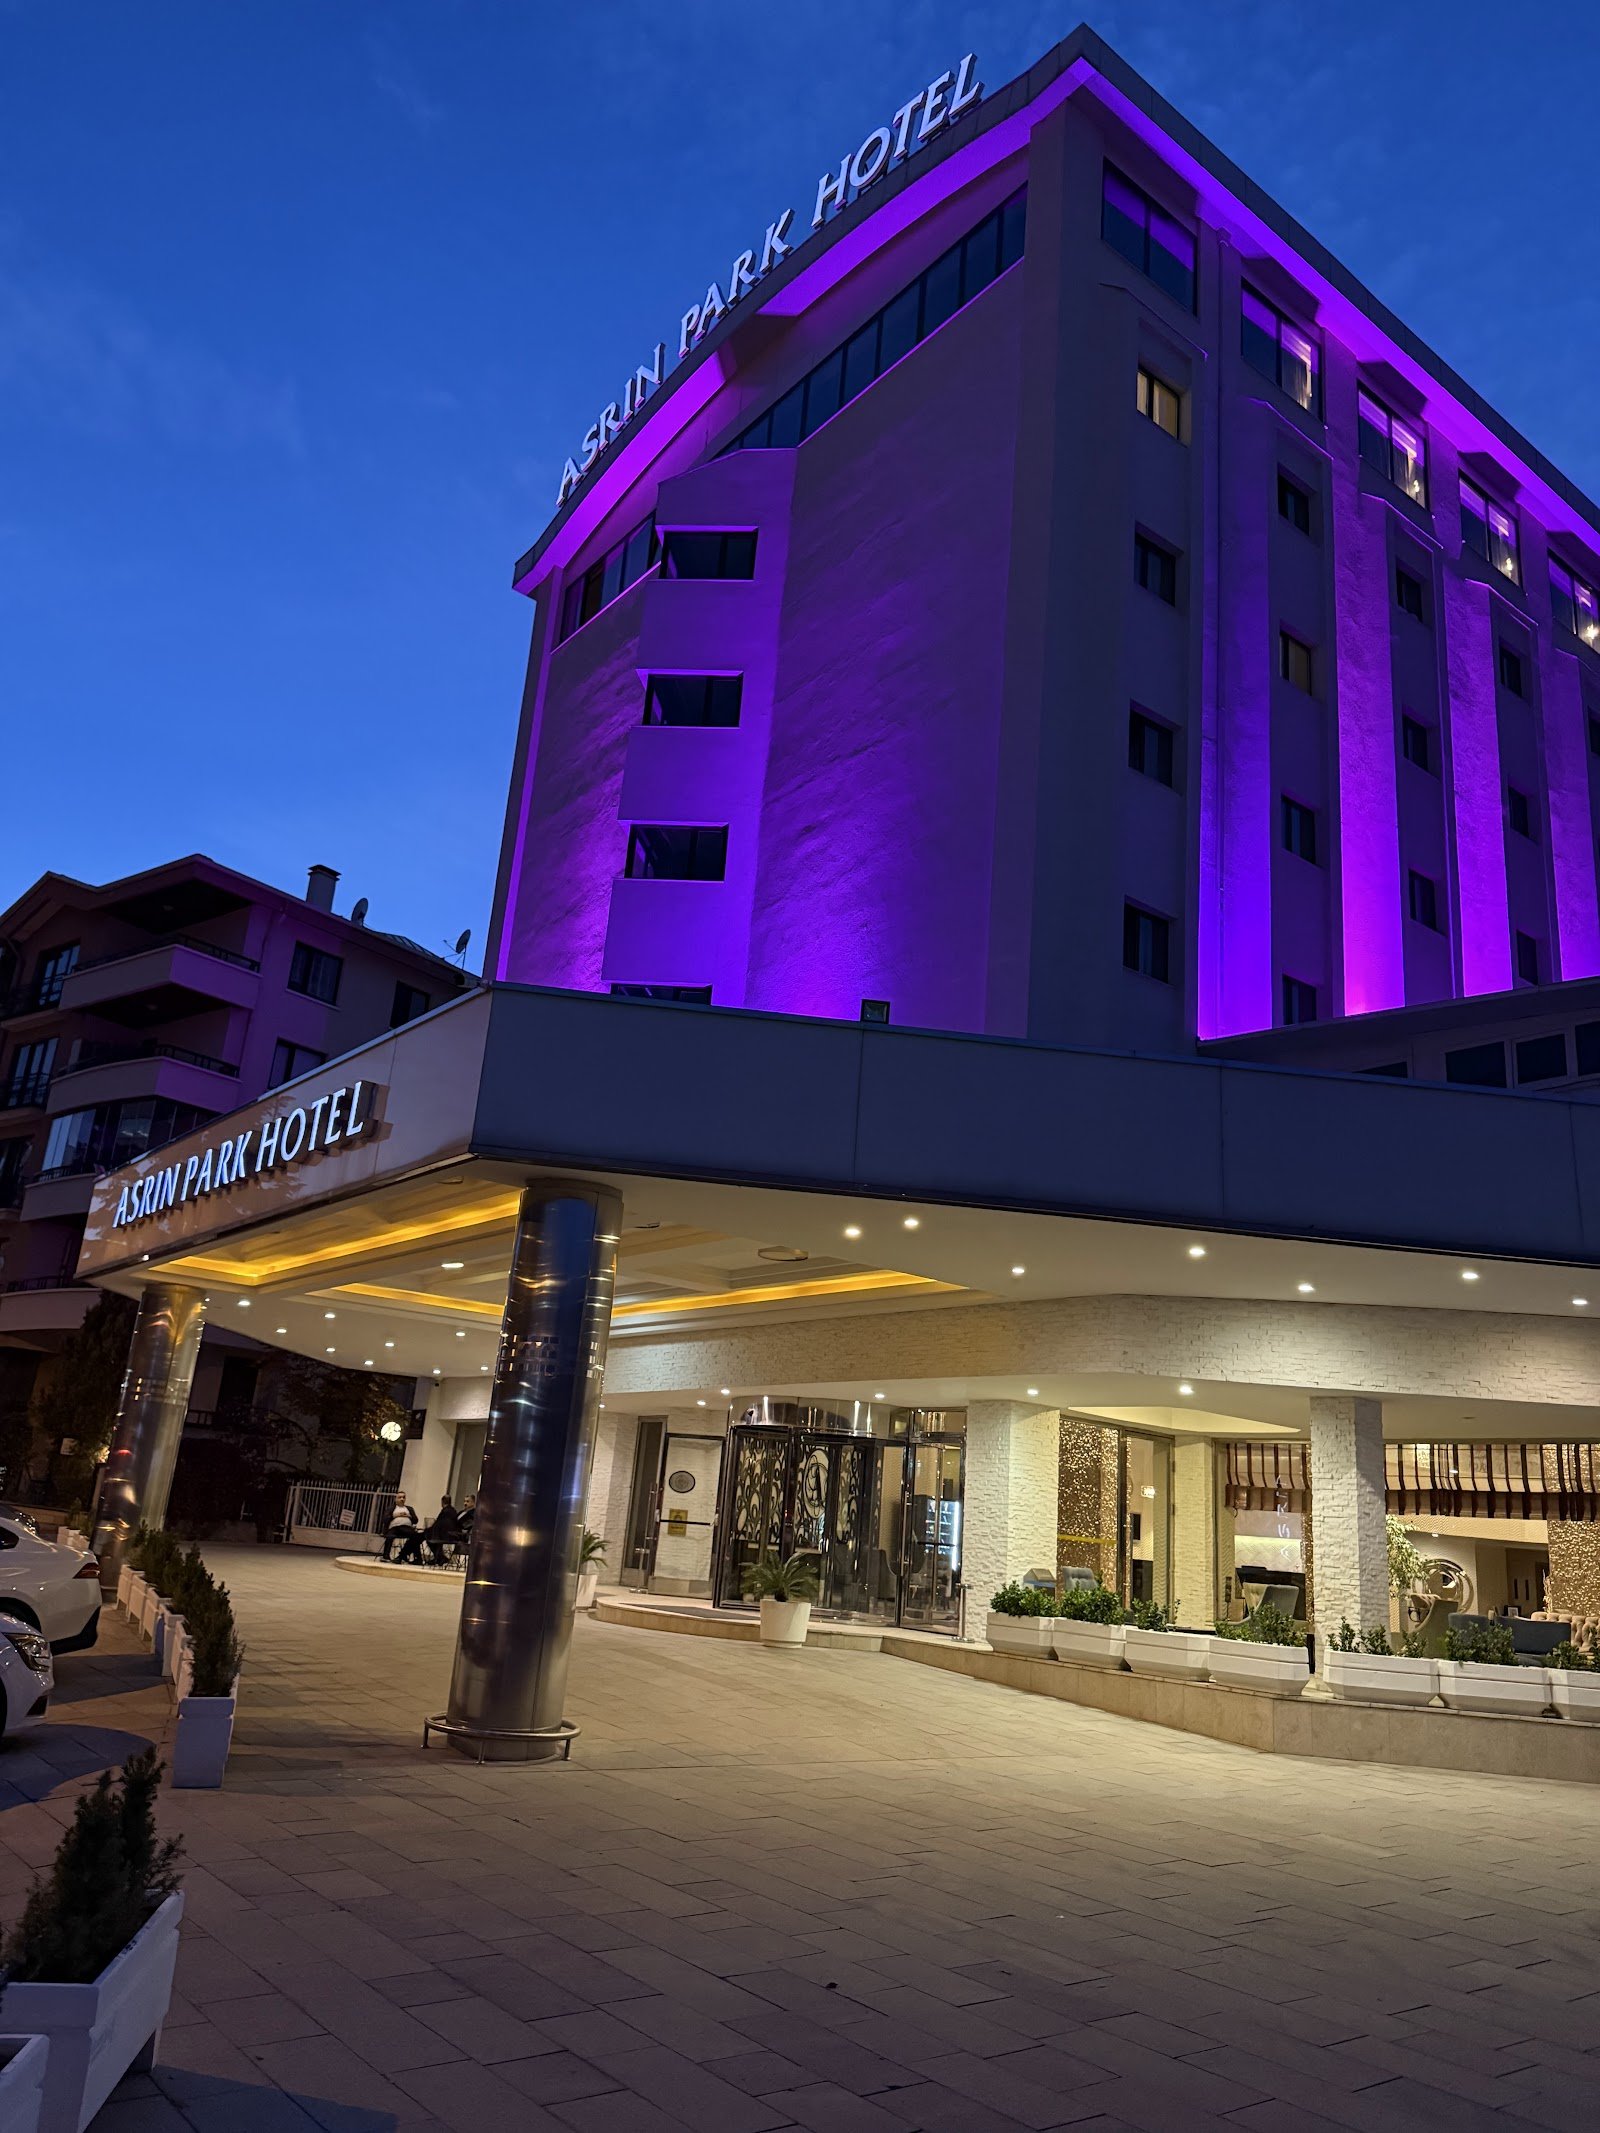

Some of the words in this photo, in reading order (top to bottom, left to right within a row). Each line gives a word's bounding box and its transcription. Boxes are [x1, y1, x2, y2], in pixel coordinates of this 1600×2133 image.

[556, 342, 665, 507] ASRIN
[678, 208, 794, 358] PARK
[811, 53, 984, 229] HOTEL
[112, 1163, 182, 1228] ASRIN
[180, 1130, 253, 1201] PARK
[255, 1081, 364, 1172] HOTEL
